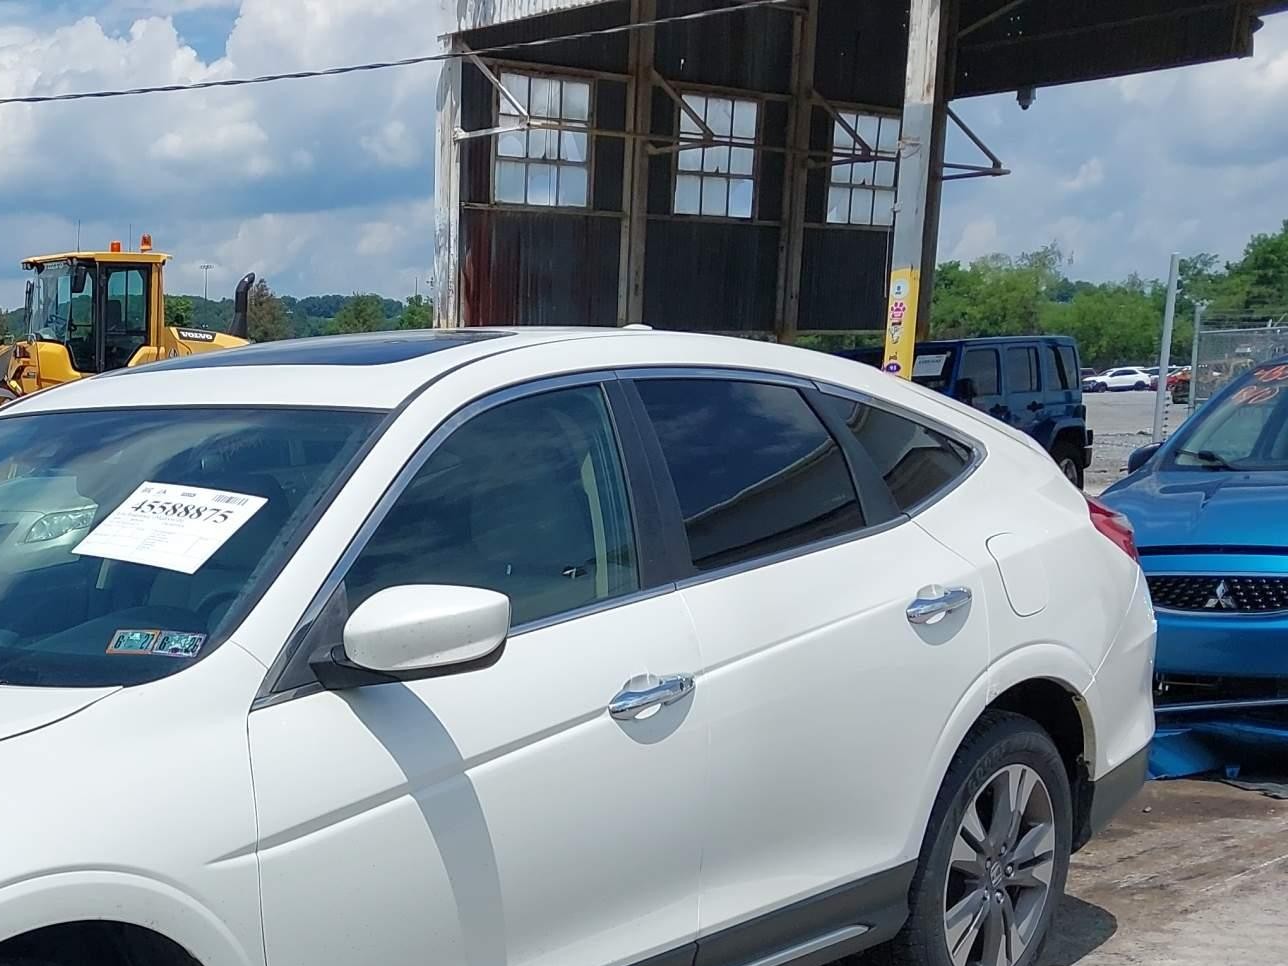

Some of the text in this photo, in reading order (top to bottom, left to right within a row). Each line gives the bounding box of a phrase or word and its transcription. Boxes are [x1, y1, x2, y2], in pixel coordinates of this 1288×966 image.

[179, 331, 213, 340] VOLVO
[131, 499, 234, 524] 45588875
[114, 635, 124, 649] 6
[159, 636, 169, 650] 6
